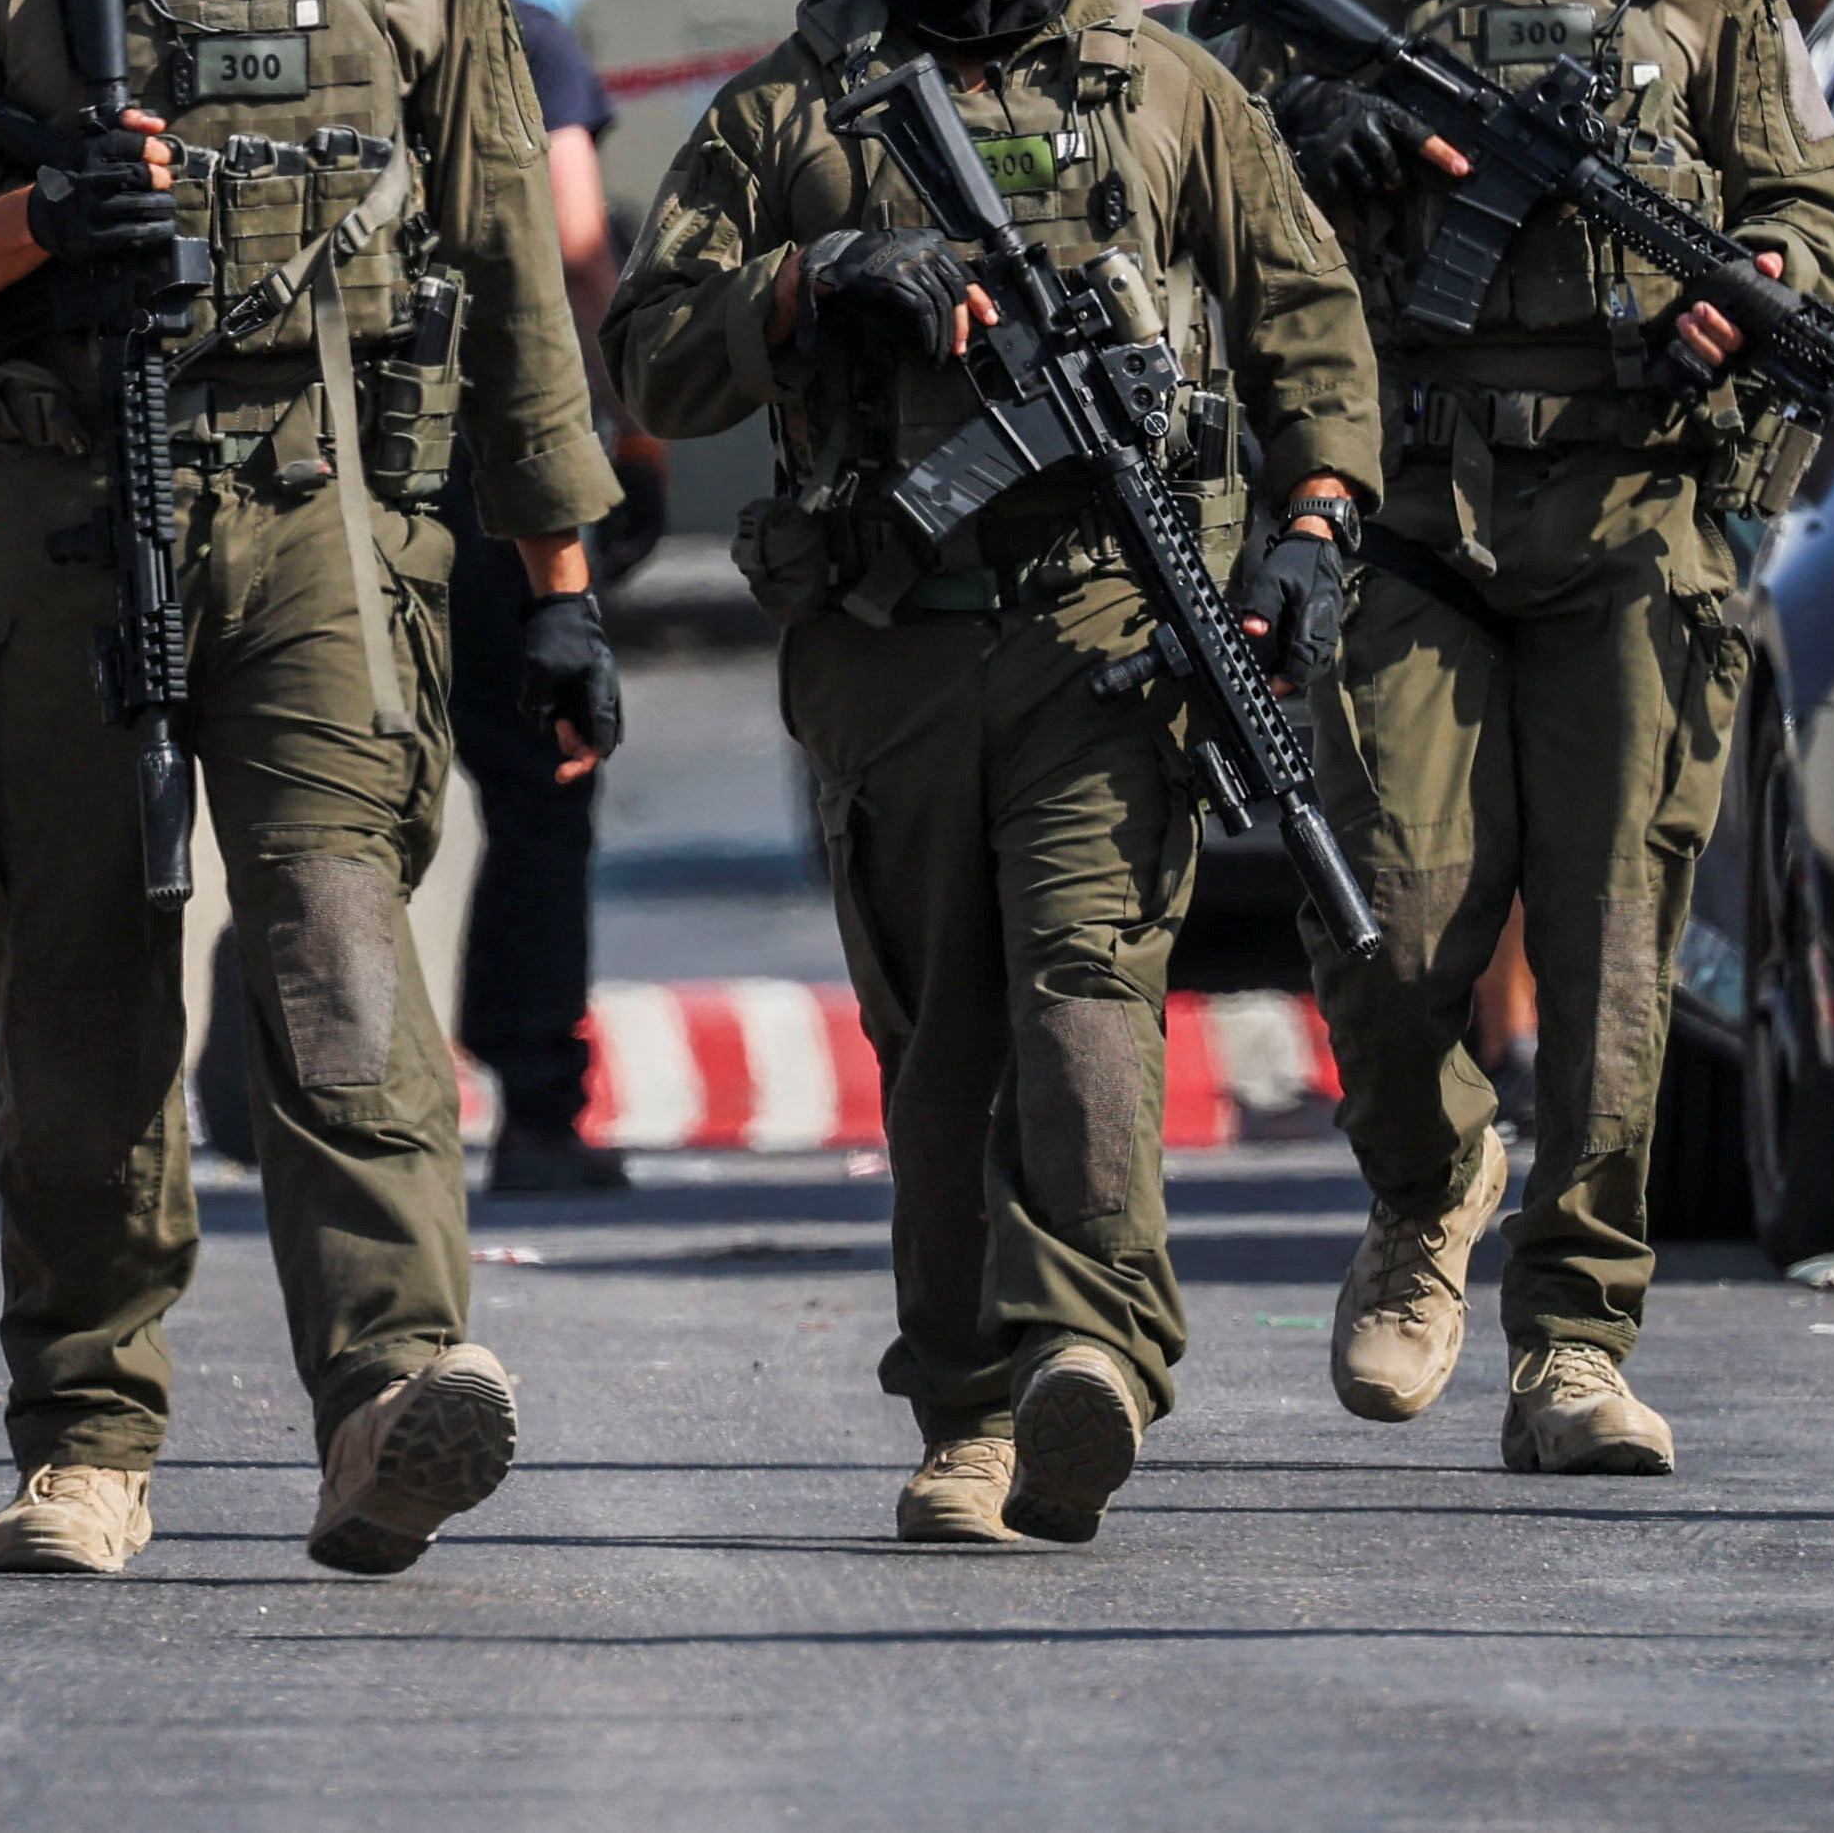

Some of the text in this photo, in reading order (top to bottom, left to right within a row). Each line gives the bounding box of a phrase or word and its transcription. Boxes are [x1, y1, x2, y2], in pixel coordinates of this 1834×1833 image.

[1508, 20, 1566, 45] 300
[221, 53, 281, 81] 300
[985, 151, 1034, 179] 300
